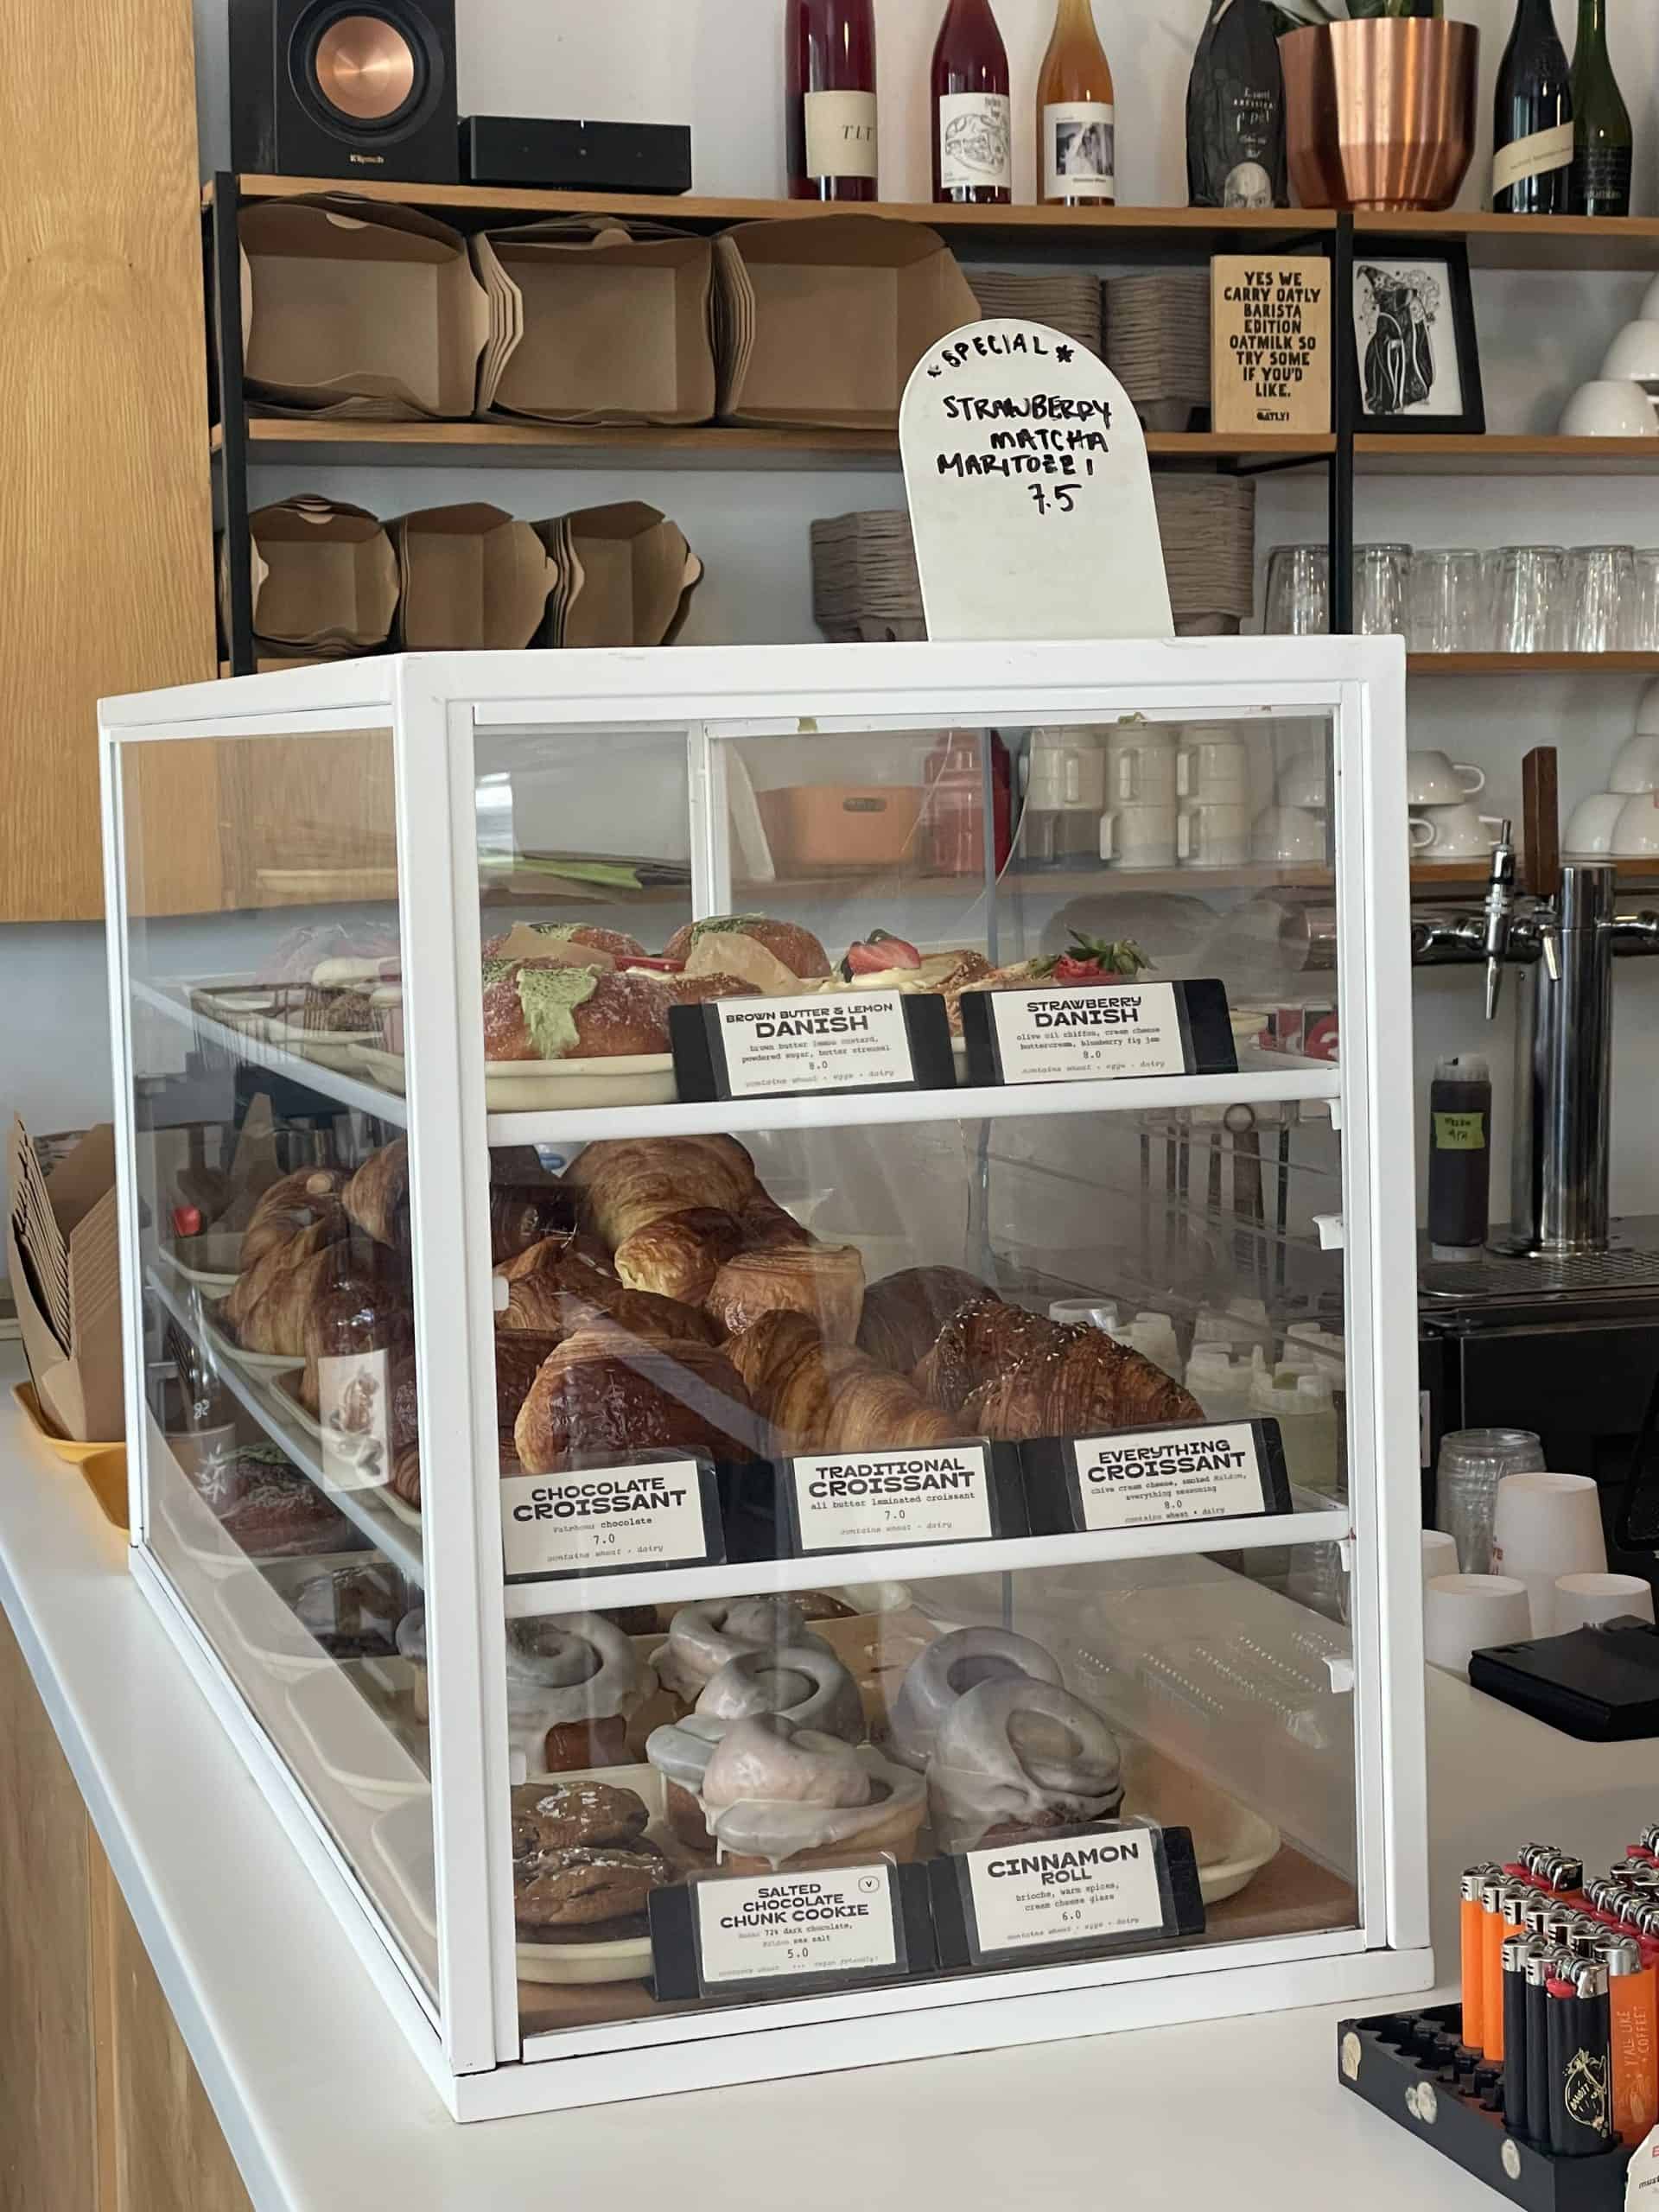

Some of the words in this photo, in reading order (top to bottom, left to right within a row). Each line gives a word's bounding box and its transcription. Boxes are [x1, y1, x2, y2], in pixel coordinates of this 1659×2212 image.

[1244, 271, 1273, 286] YES
[1280, 271, 1302, 286] WE
[1224, 288, 1271, 302] CARRY
[1277, 288, 1320, 303] OATLY
[1243, 304, 1301, 318] BARISTA
[1244, 319, 1301, 334] EDITION
[1230, 335, 1293, 350] OATMILK
[1300, 336, 1316, 350] SO
[1236, 351, 1262, 365] TRY
[1269, 352, 1310, 365] SOME
[1243, 367, 1256, 381] IF
[1262, 366, 1303, 381] YOU'D
[1255, 383, 1291, 397] LIKE.
[1256, 410, 1289, 422] OATLY!
[990, 429, 1109, 452] MATCHA
[937, 453, 1094, 477] MARITOZZI
[1027, 483, 1083, 515] 7.5
[1027, 996, 1142, 1012] STRAWBERRY
[726, 1013, 776, 1023] BROWN
[780, 1008, 830, 1020] BUTTER
[833, 1006, 843, 1015] &
[848, 1003, 893, 1014] LEMON
[1035, 1008, 1139, 1027] DANISH
[756, 1015, 868, 1038] DANISH
[1099, 1440, 1230, 1464] EVERYTHING
[815, 1458, 966, 1480] TRADITIONAL
[1088, 1452, 1246, 1483] CROISSANT
[531, 1477, 665, 1502] CHOCOLATE
[809, 1471, 976, 1497] CROISSANT
[513, 1490, 687, 1522] CROISSANT
[810, 1501, 828, 1510] all
[832, 1499, 867, 1508] butter
[925, 1492, 976, 1501] croissant
[601, 1517, 653, 1529] chocolate
[885, 1510, 906, 1520] 7.0
[594, 1534, 615, 1545] 7.0
[987, 1842, 1139, 1878] CINNAMON
[1041, 1868, 1093, 1885] ROLL
[758, 1884, 822, 1898] SALTED
[743, 1893, 844, 1912] CHOCOLATE
[720, 1911, 789, 1929] CHUNK
[791, 1904, 869, 1922] COOKIE
[1062, 1910, 1082, 1921] 6.0
[787, 1948, 809, 1959] 5.0
